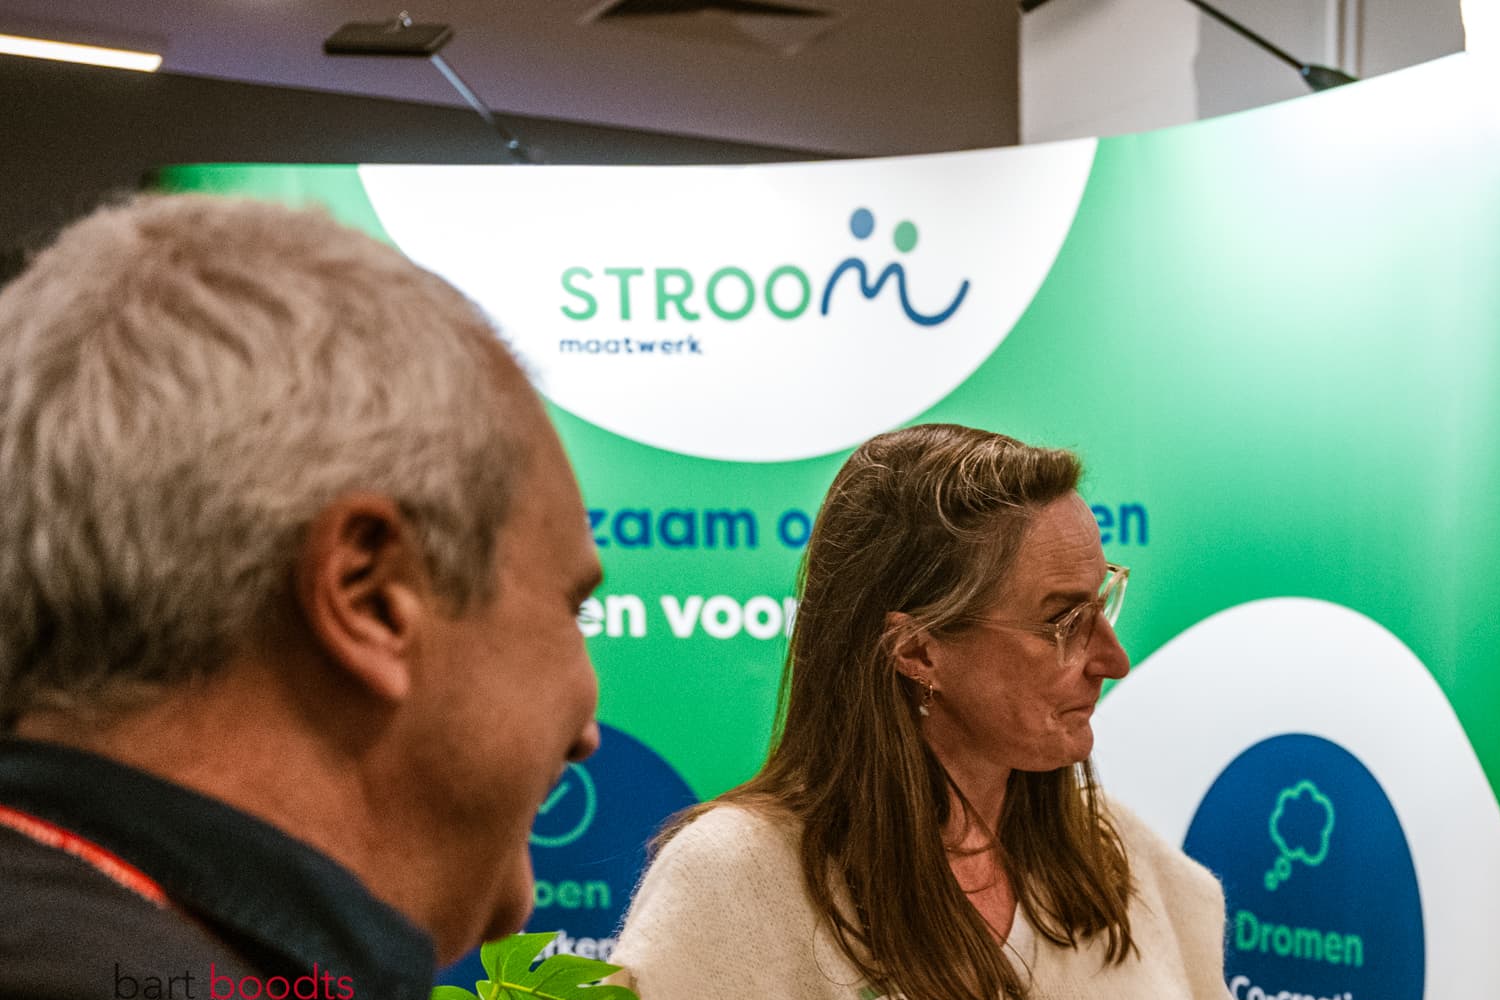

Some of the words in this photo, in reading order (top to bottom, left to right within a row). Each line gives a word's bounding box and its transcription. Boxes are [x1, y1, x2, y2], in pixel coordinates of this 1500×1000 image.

[560, 207, 970, 327] STROOM
[559, 336, 704, 355] maatwerk
[588, 508, 757, 549] zaam
[534, 880, 611, 909] oen
[1236, 910, 1364, 967] Dromen
